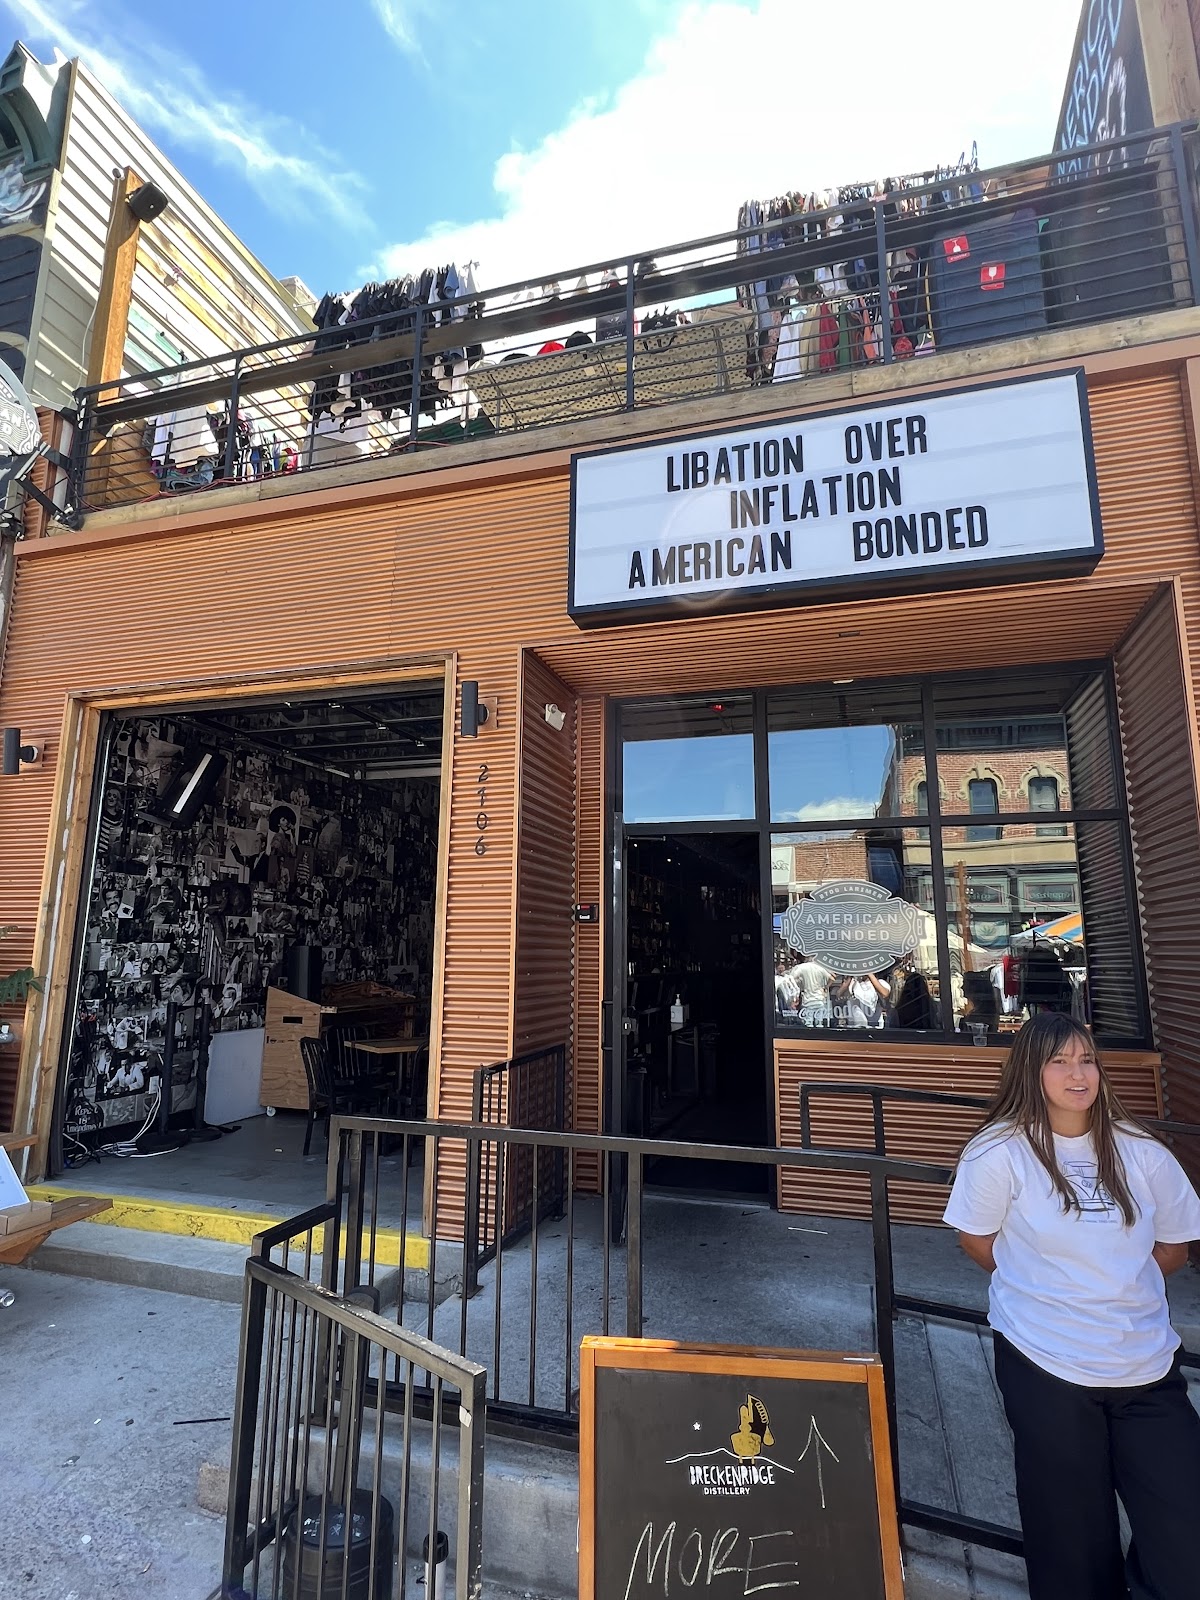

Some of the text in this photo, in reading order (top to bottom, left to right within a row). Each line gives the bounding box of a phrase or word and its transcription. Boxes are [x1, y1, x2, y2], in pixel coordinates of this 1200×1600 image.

[667, 415, 928, 492] LIBATION OVER
[730, 466, 902, 529] INFLATION
[628, 505, 989, 589] AMERICAN BONDED
[843, 886, 883, 899] LARIMER
[805, 913, 899, 926] AMERICAN
[815, 929, 890, 941] BONDED
[822, 955, 857, 969] DENVER
[689, 1465, 775, 1486] BRECKENRIDGE
[703, 1487, 751, 1495] DISTILLERY
[624, 1521, 800, 1600] MORE
